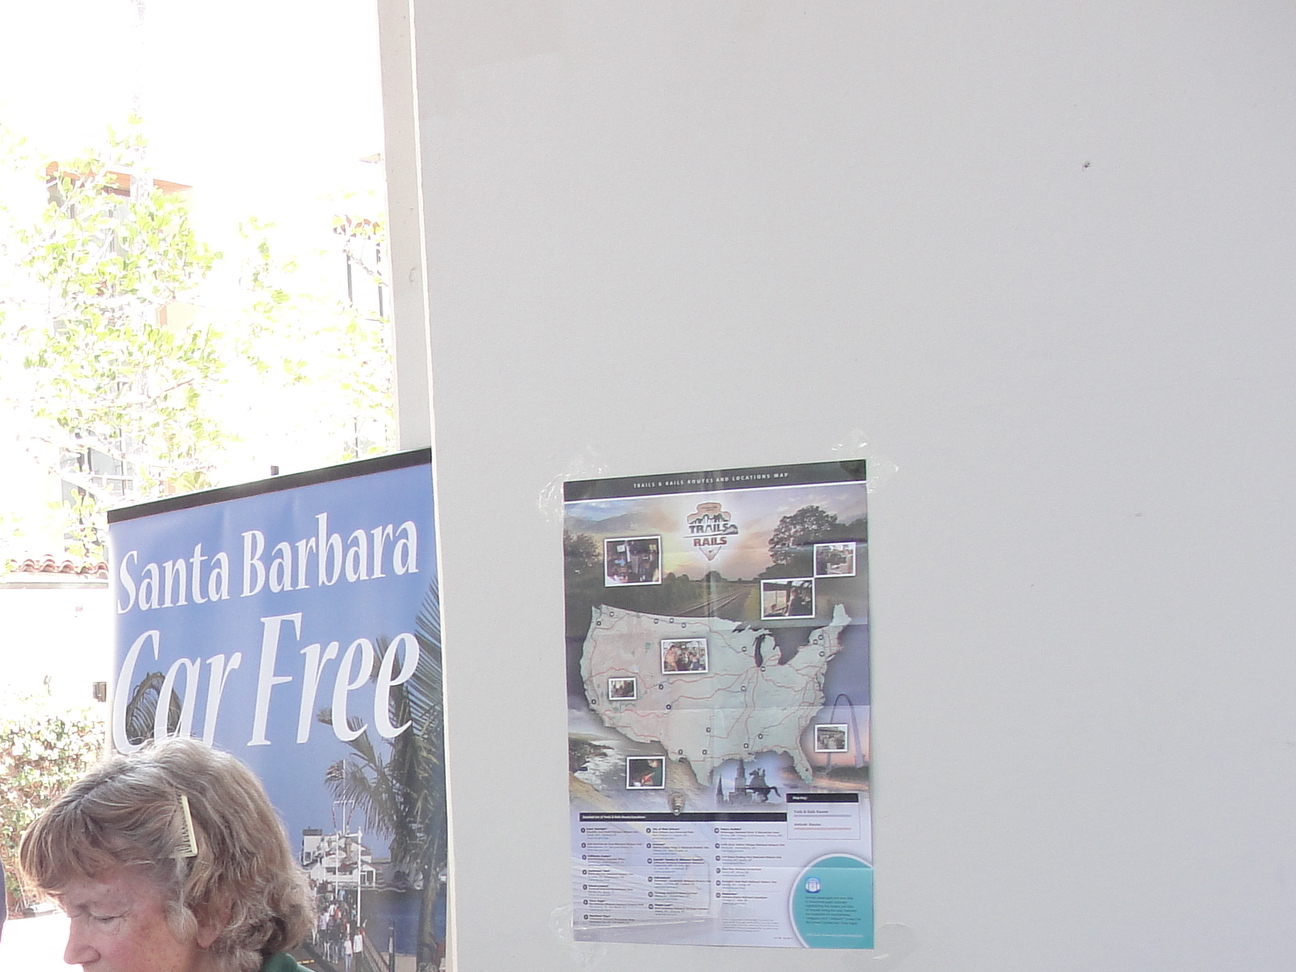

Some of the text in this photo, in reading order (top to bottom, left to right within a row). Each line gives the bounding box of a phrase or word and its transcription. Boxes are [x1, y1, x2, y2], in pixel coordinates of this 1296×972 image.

[688, 523, 729, 534] TRAILS
[693, 536, 728, 547] RAILS
[117, 512, 420, 614] Santa Barbara
[112, 612, 420, 754] Car Free
